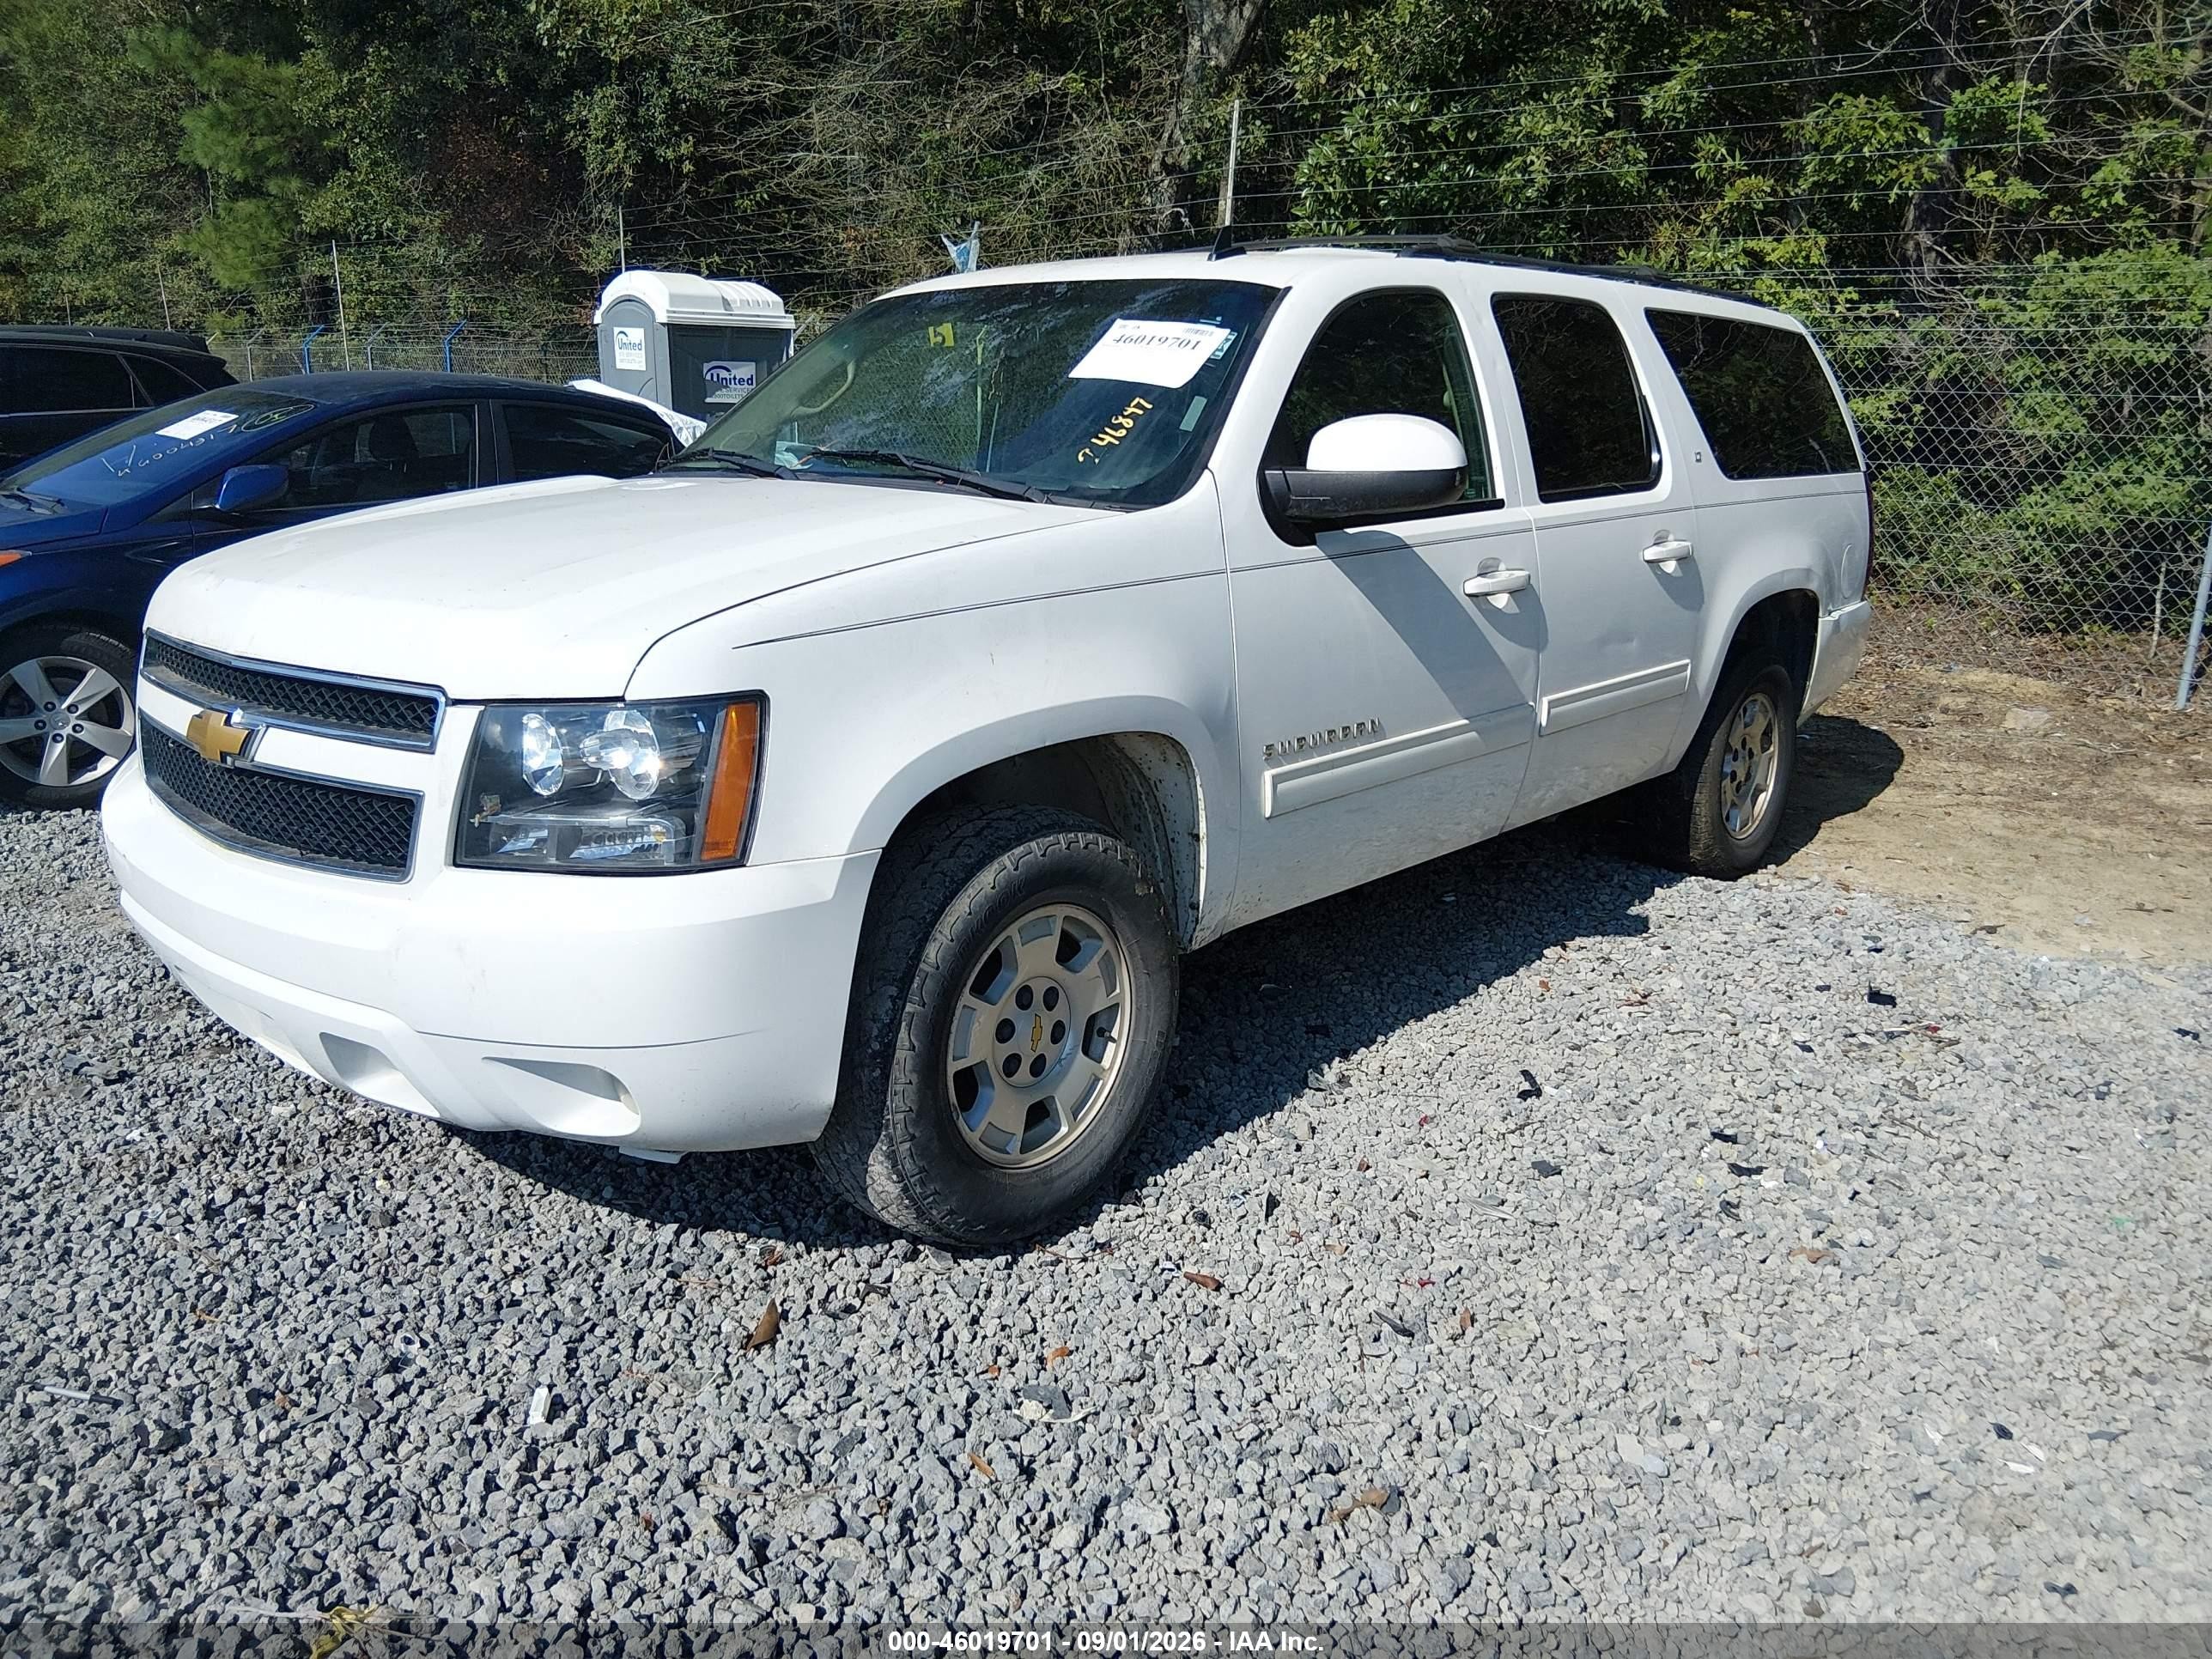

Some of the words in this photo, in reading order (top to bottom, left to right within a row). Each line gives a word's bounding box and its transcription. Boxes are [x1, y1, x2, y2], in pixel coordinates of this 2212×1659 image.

[617, 337, 642, 350] United
[1113, 333, 1202, 351] 46019701
[710, 372, 754, 386] United
[1263, 718, 1380, 759] SUBURBAN
